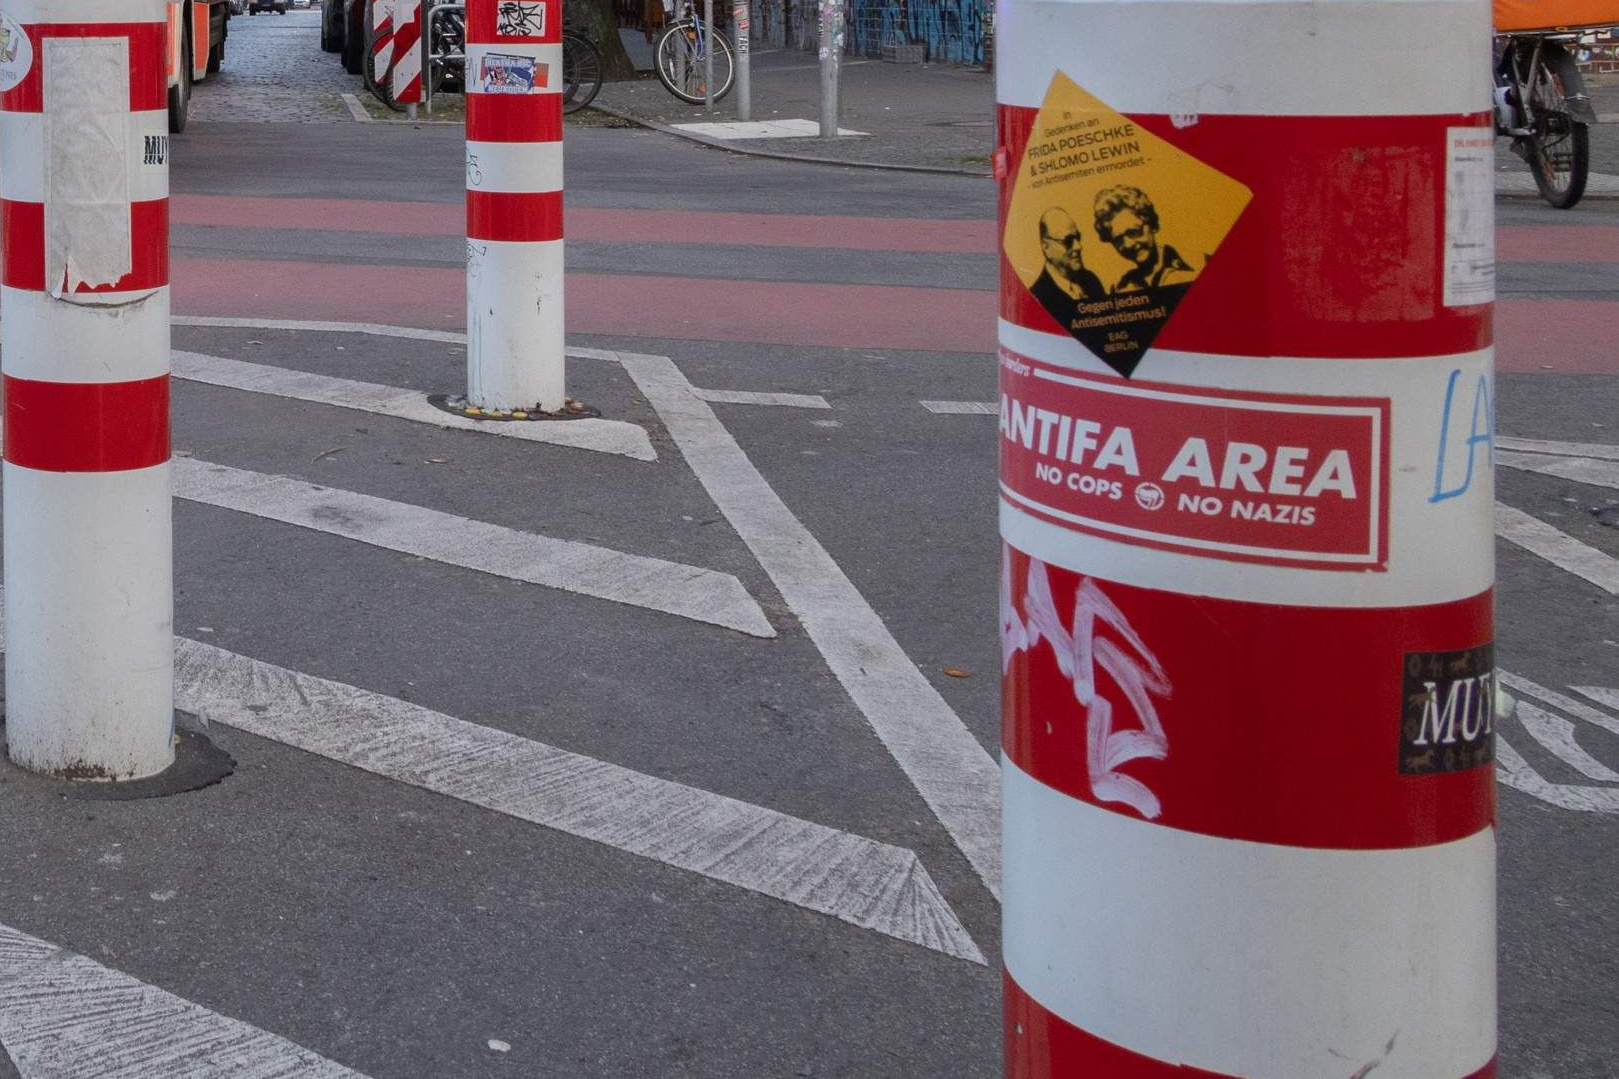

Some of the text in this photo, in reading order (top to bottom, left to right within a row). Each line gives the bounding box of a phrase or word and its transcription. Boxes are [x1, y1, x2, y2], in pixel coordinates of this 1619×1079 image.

[1028, 123, 1135, 160] FRIDA POESCHKE
[1030, 140, 1141, 177] & SHLOMO LEWIN
[1096, 156, 1146, 175] ermordet
[1070, 306, 1167, 330] Antisemitismus!
[1077, 294, 1150, 315] Gegen jeden
[1103, 341, 1139, 354] BERLIN
[998, 391, 1358, 500] ANTIFA AREA
[1036, 461, 1317, 527] NO COPS NO NAZIS
